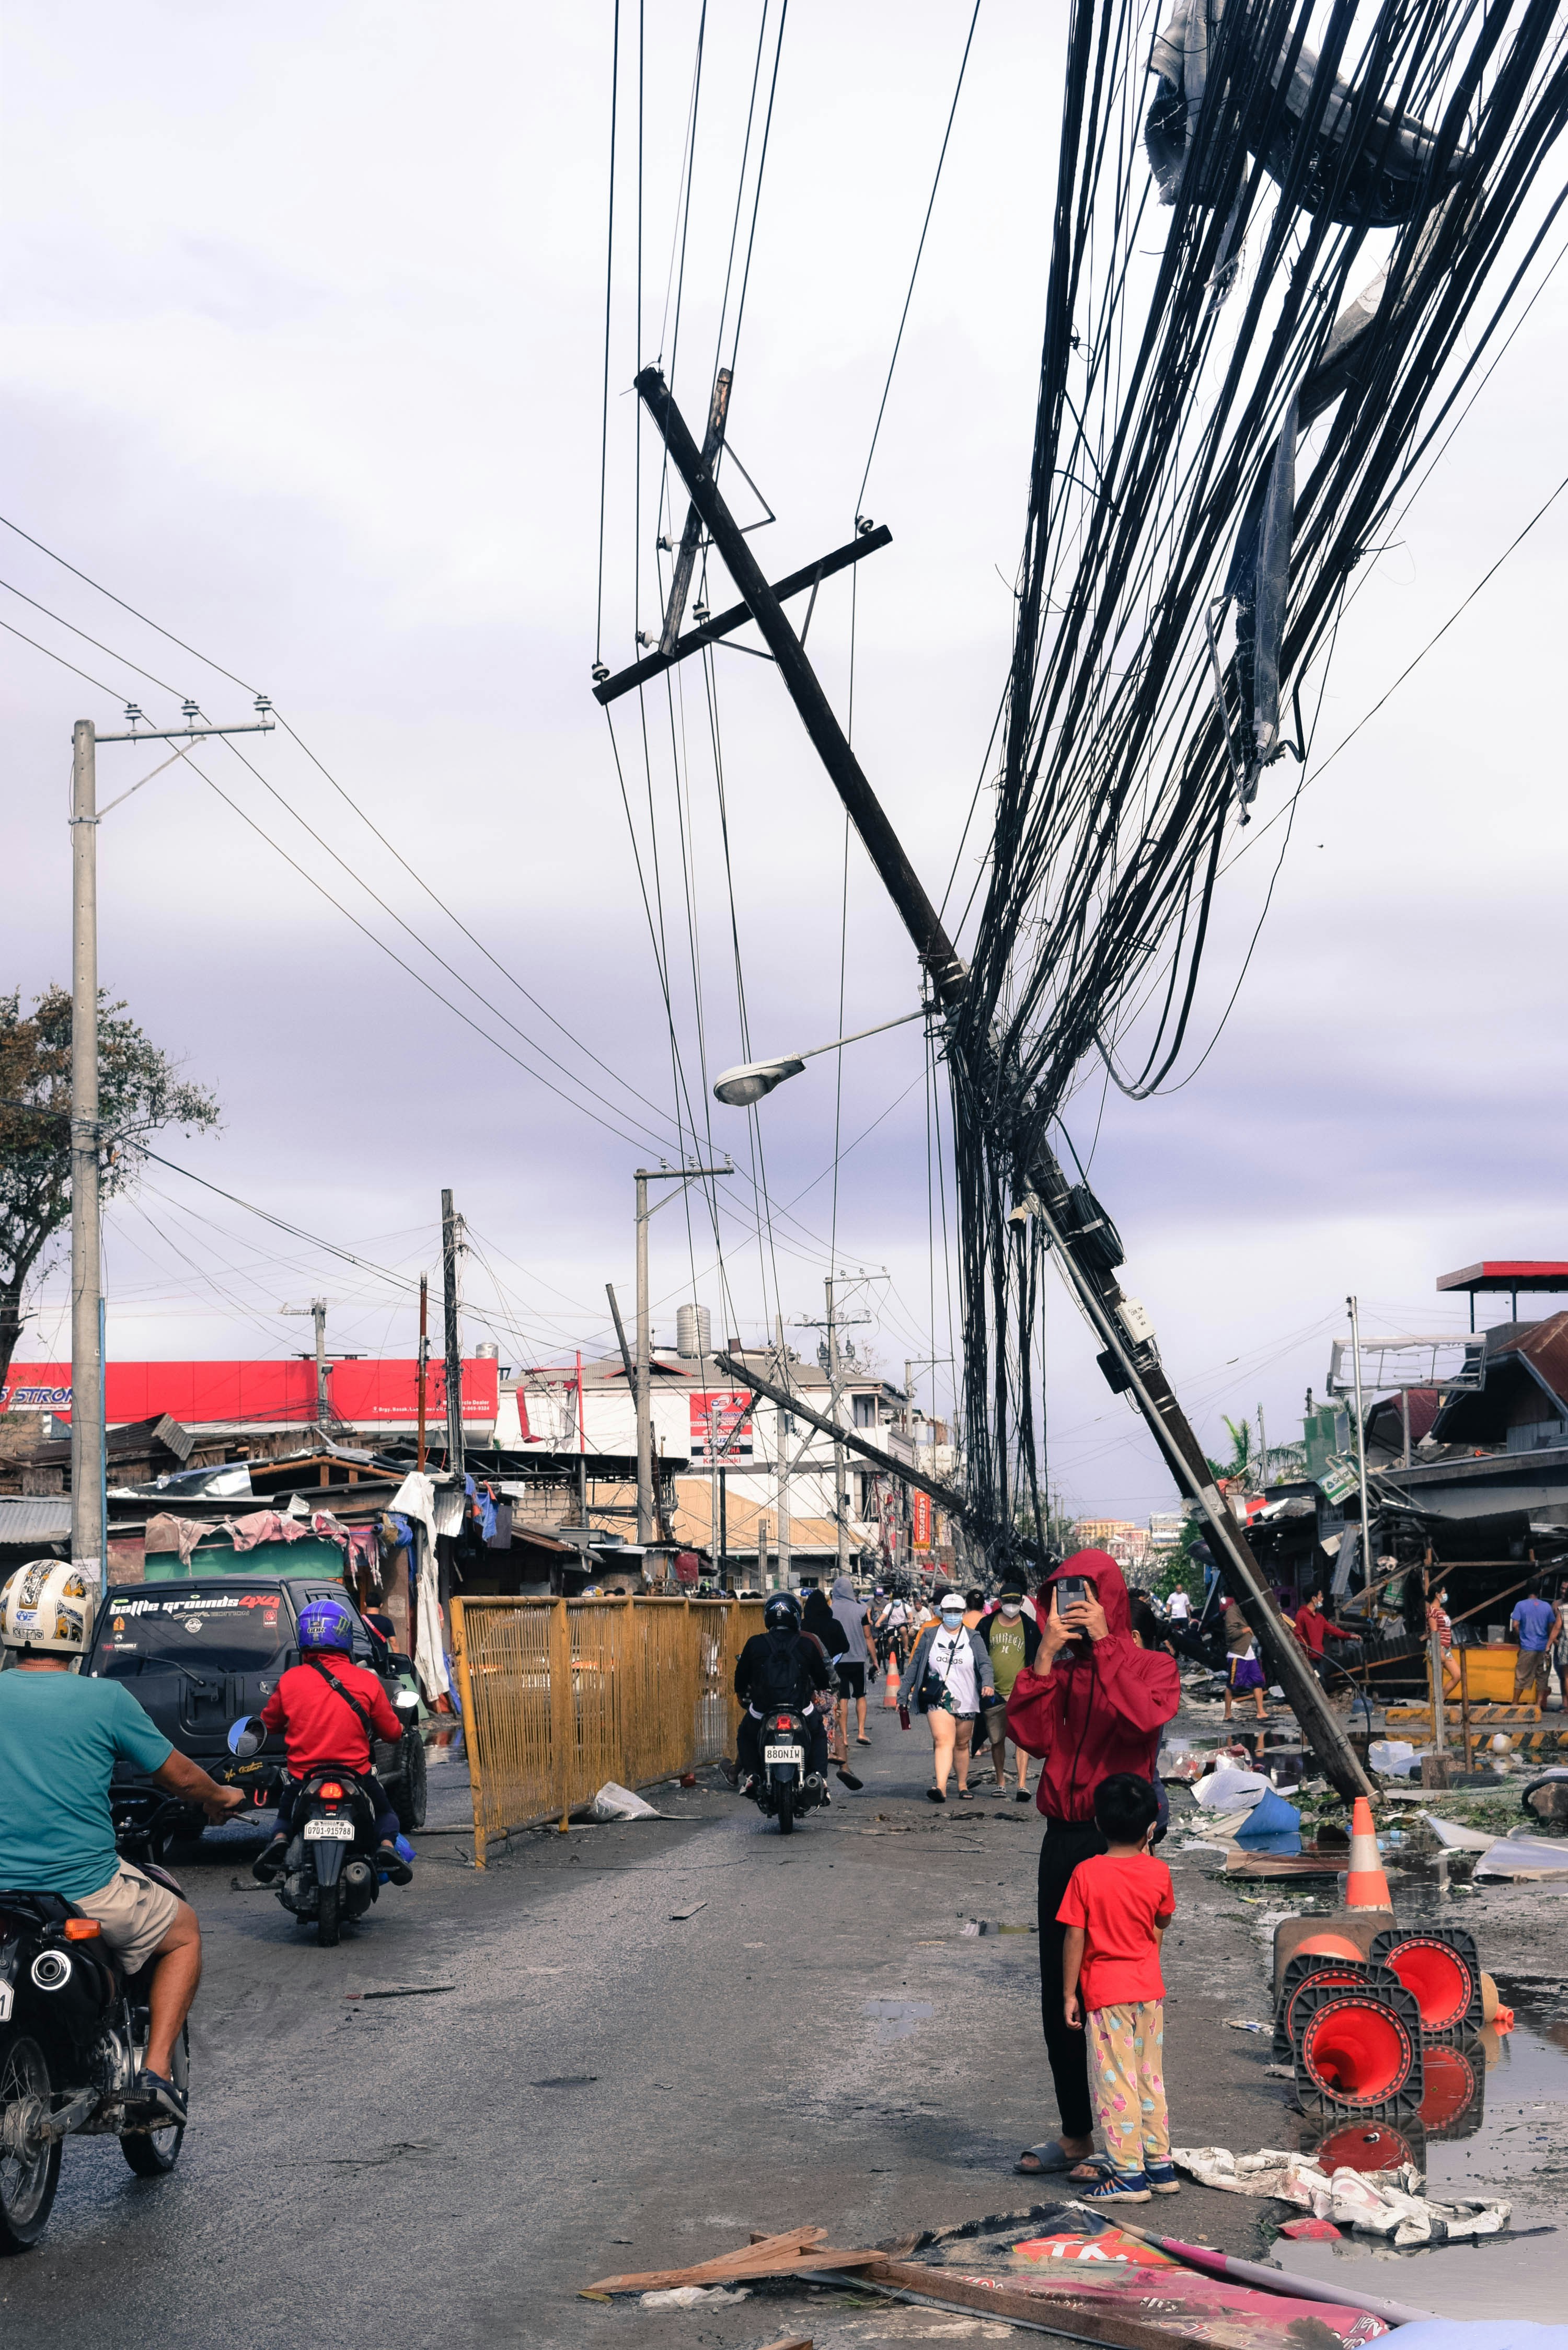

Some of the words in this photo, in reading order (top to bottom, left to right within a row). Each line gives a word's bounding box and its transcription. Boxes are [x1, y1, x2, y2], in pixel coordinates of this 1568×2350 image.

[11, 1388, 72, 1402] STRO
[163, 1596, 239, 1614] grounds
[936, 1656, 963, 1665] adias
